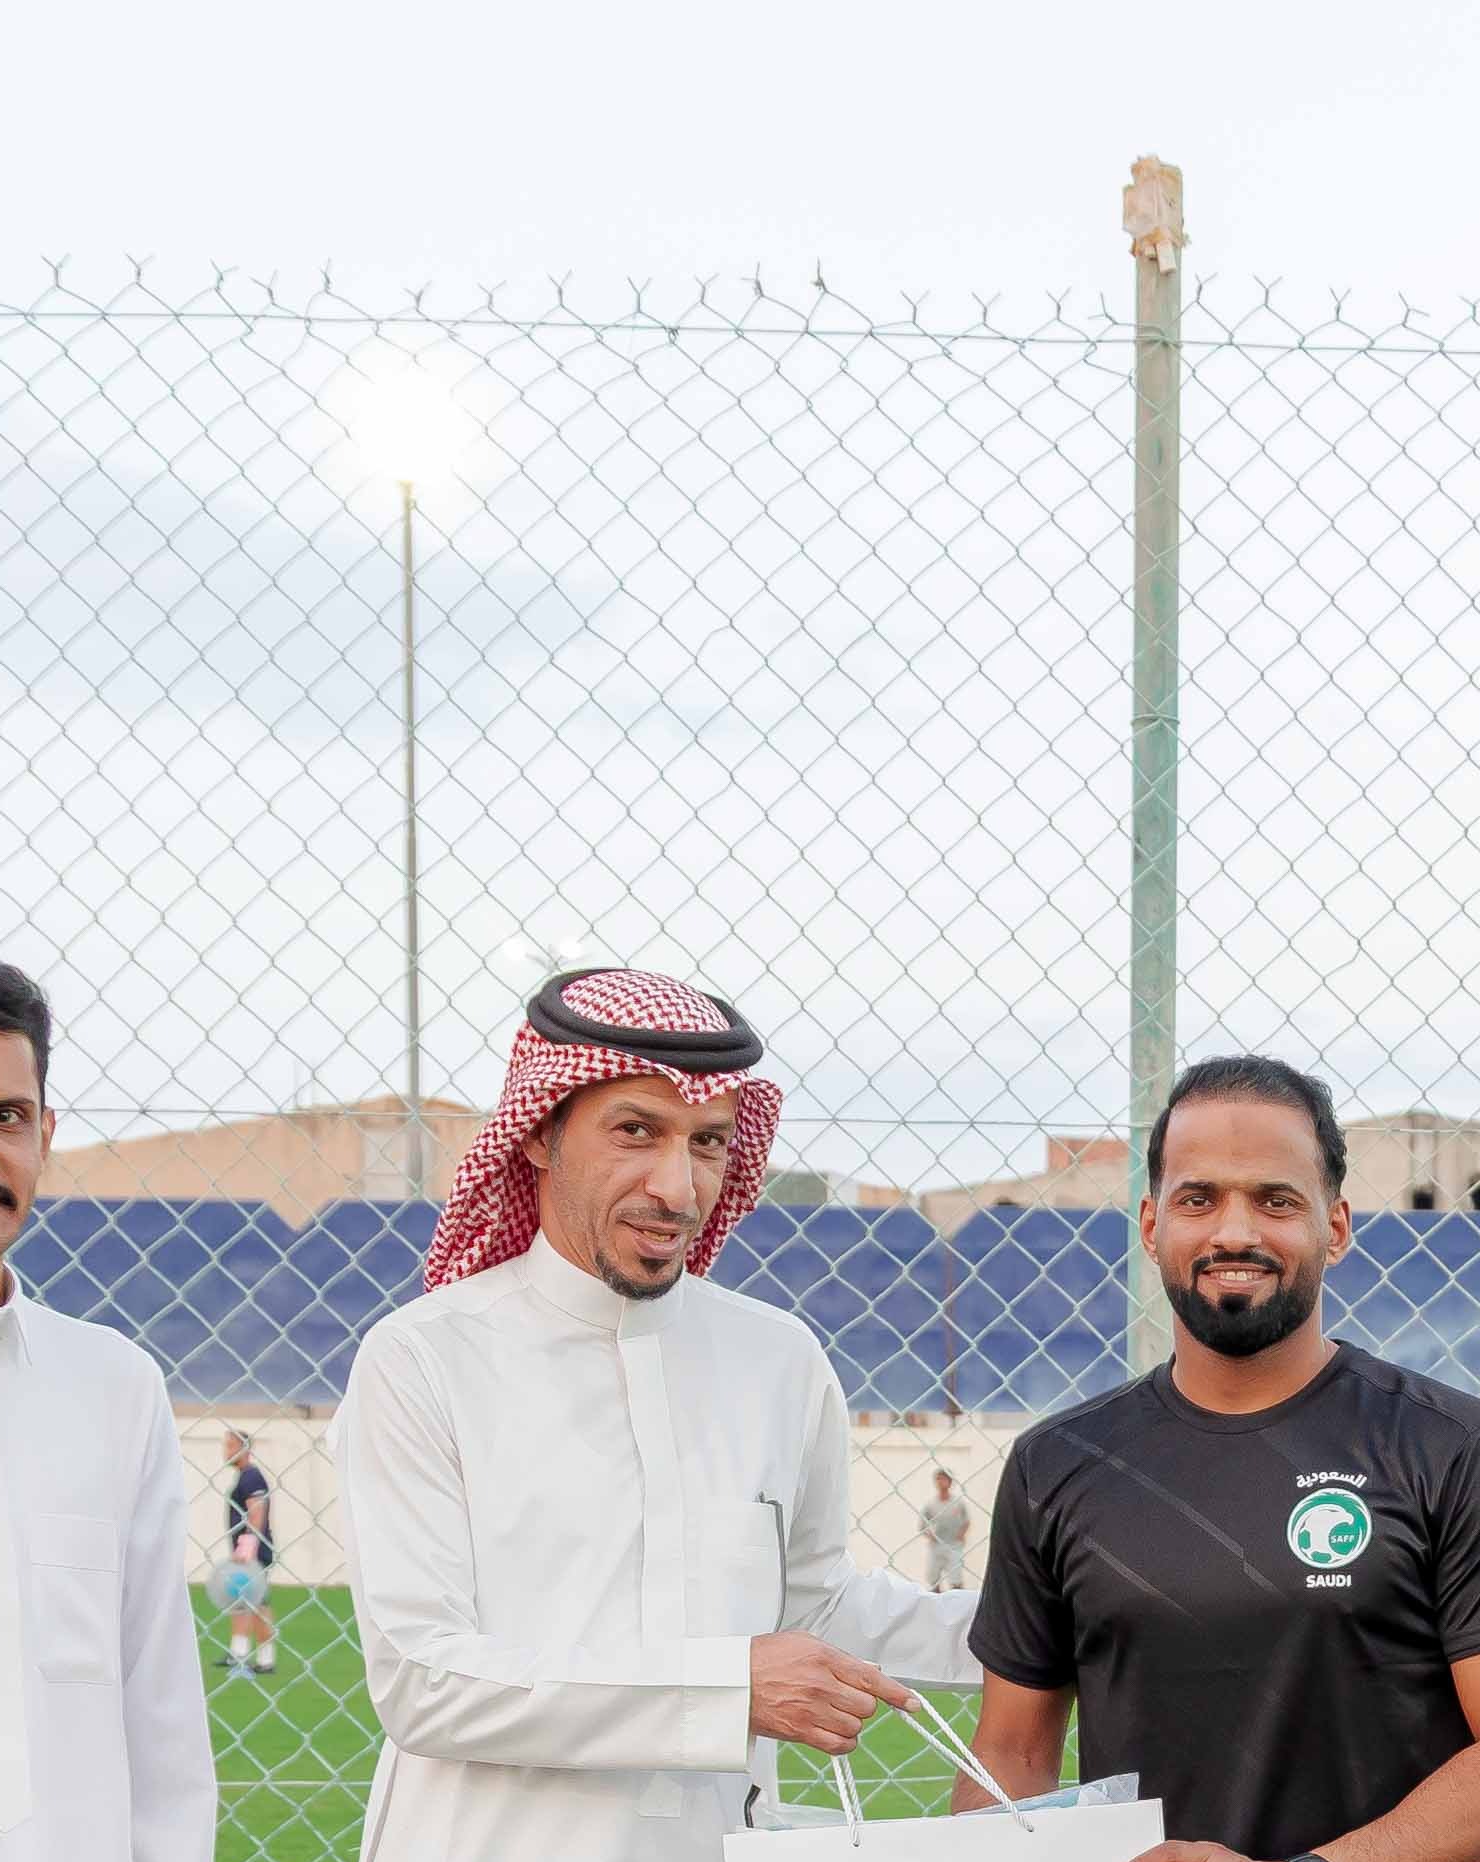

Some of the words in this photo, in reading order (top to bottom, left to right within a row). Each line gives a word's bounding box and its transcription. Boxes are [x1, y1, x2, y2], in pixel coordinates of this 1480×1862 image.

[1296, 1471, 1368, 1488] السعودية
[1331, 1535, 1355, 1544] SAFF
[1306, 1574, 1352, 1588] SAUDI
